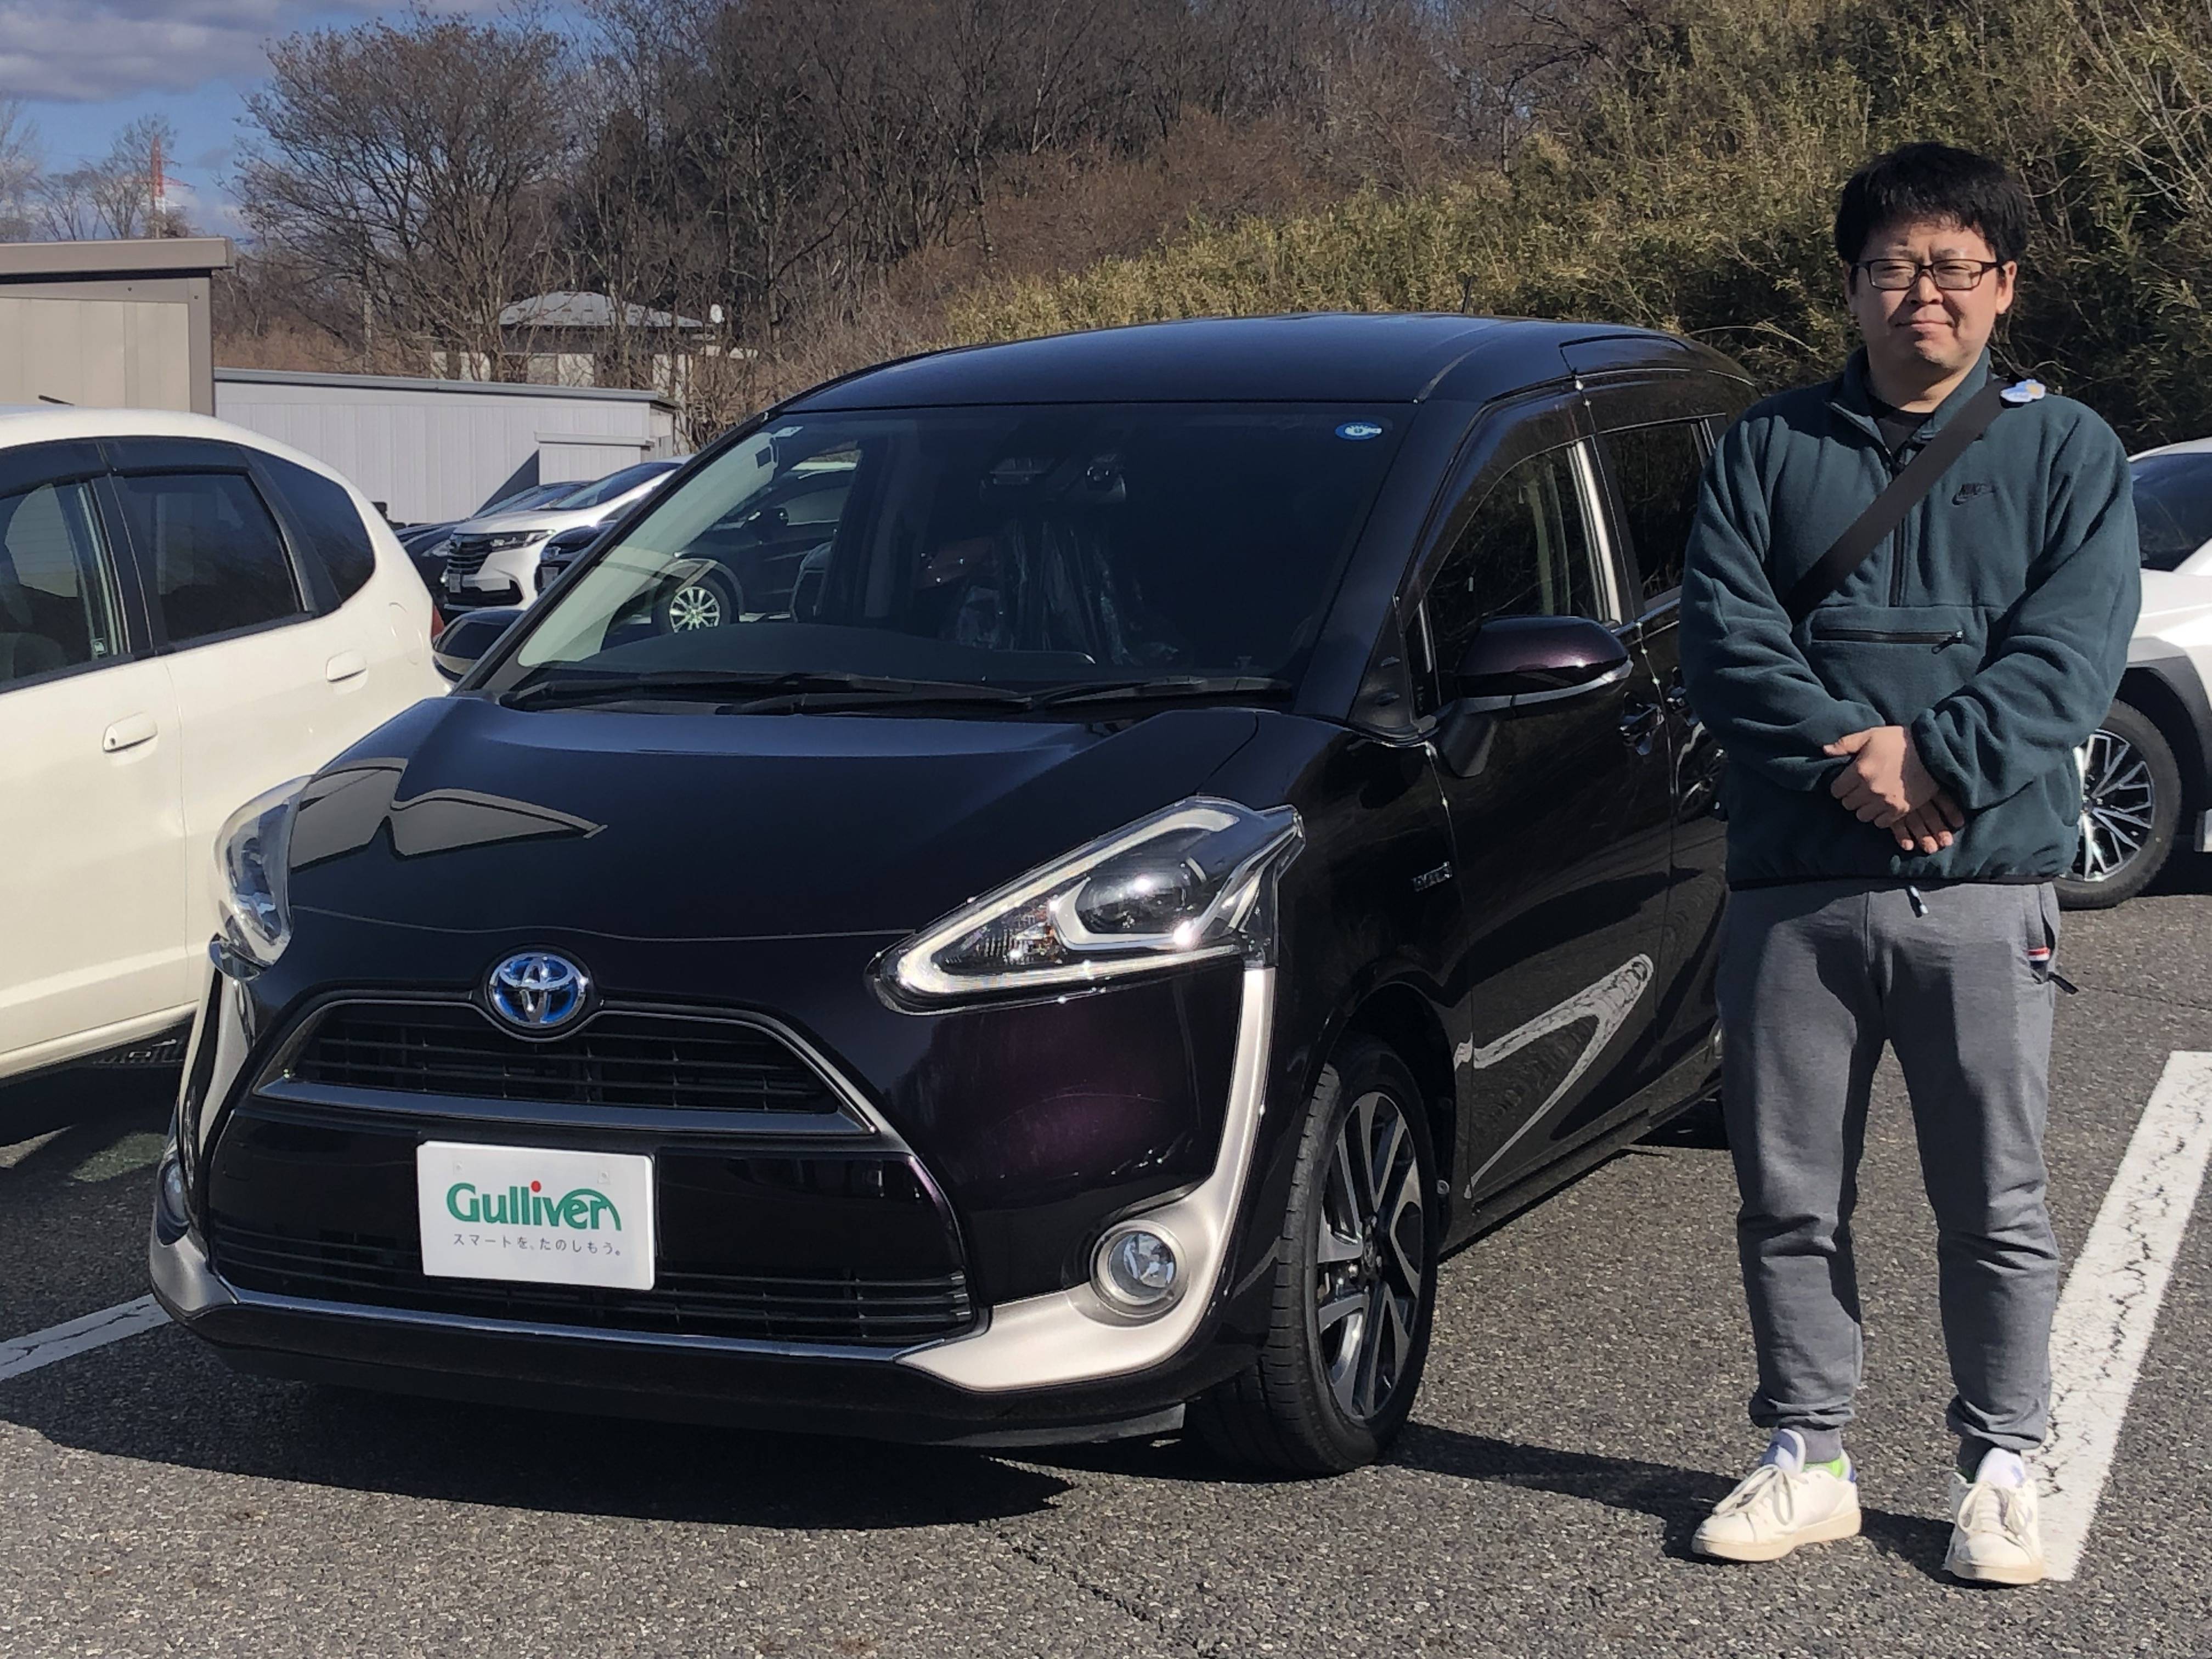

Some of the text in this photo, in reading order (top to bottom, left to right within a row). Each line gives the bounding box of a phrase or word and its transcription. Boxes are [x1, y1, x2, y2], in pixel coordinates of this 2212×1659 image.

[447, 1181, 622, 1231] Gulliver
[453, 1233, 621, 1256] スマートを、たのしもう。
